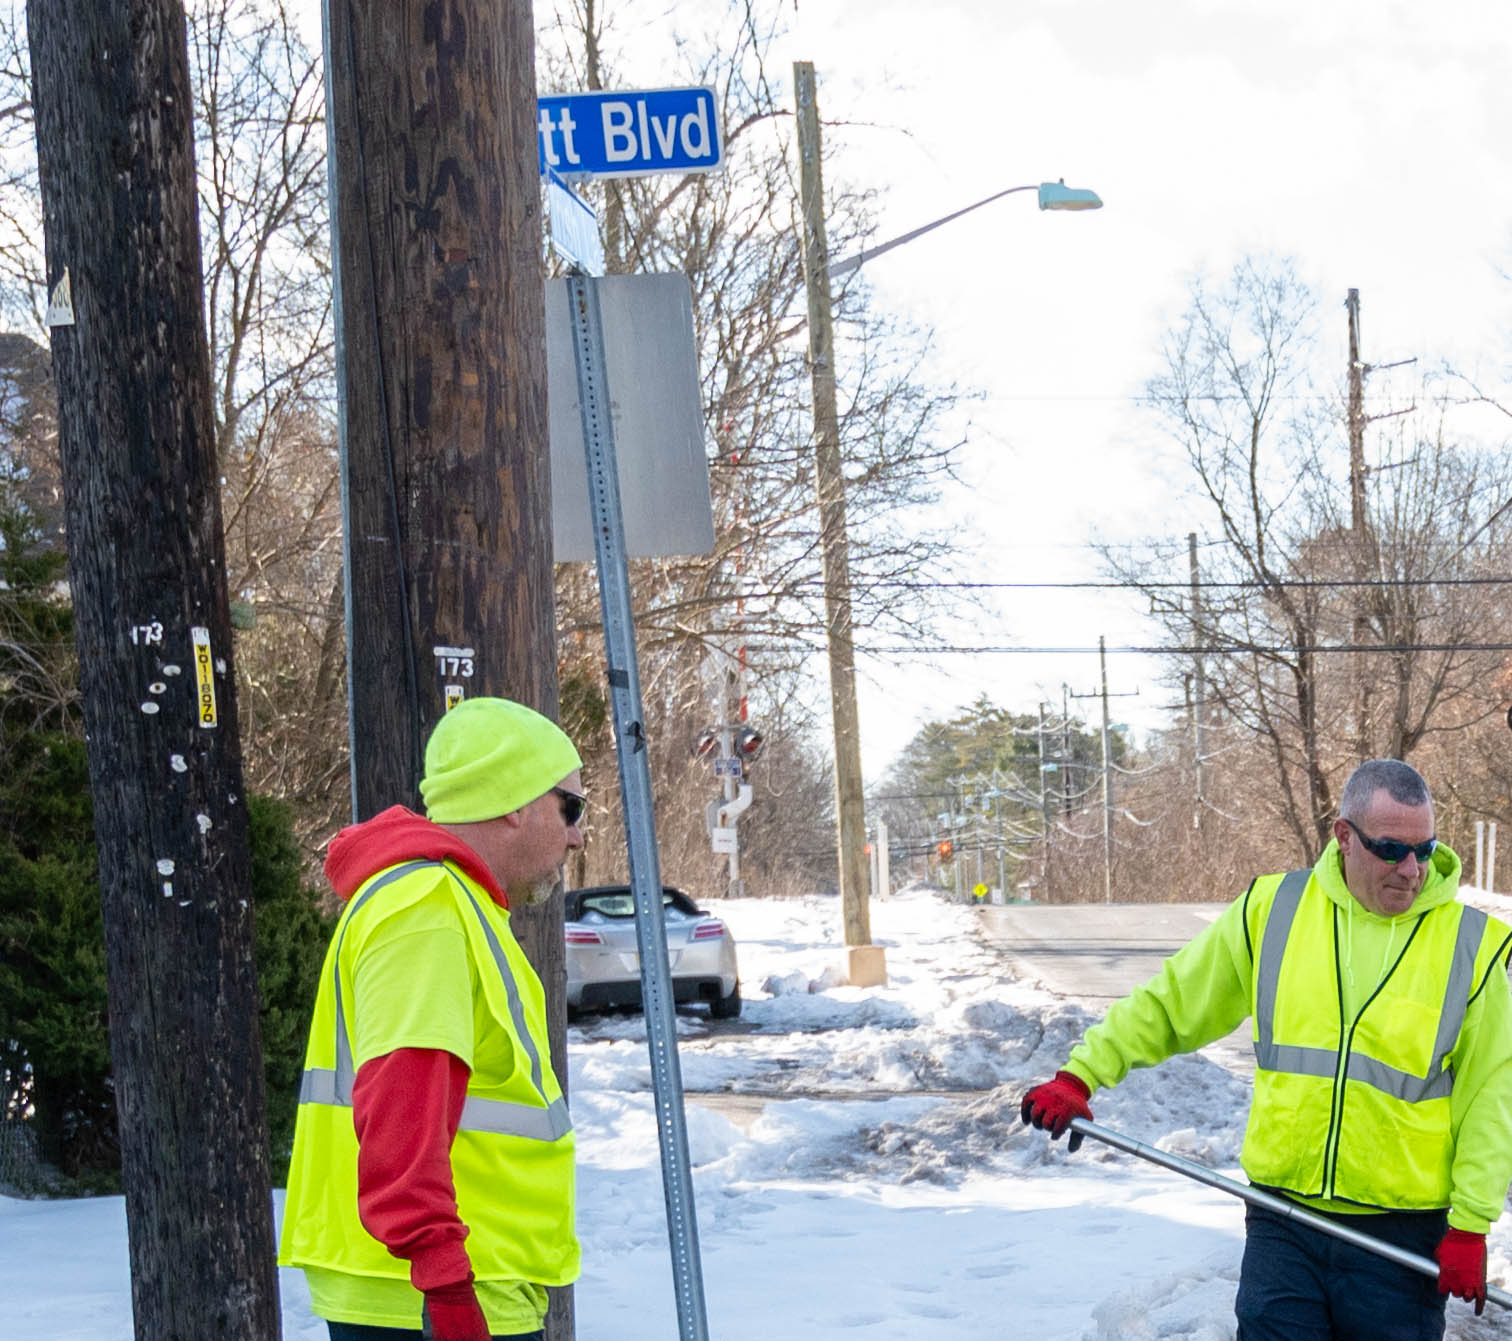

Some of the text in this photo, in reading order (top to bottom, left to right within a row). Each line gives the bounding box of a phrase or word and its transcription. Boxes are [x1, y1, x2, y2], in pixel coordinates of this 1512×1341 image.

[601, 97, 711, 163] Blvd
[132, 622, 163, 645] 173
[440, 657, 473, 677] 173
